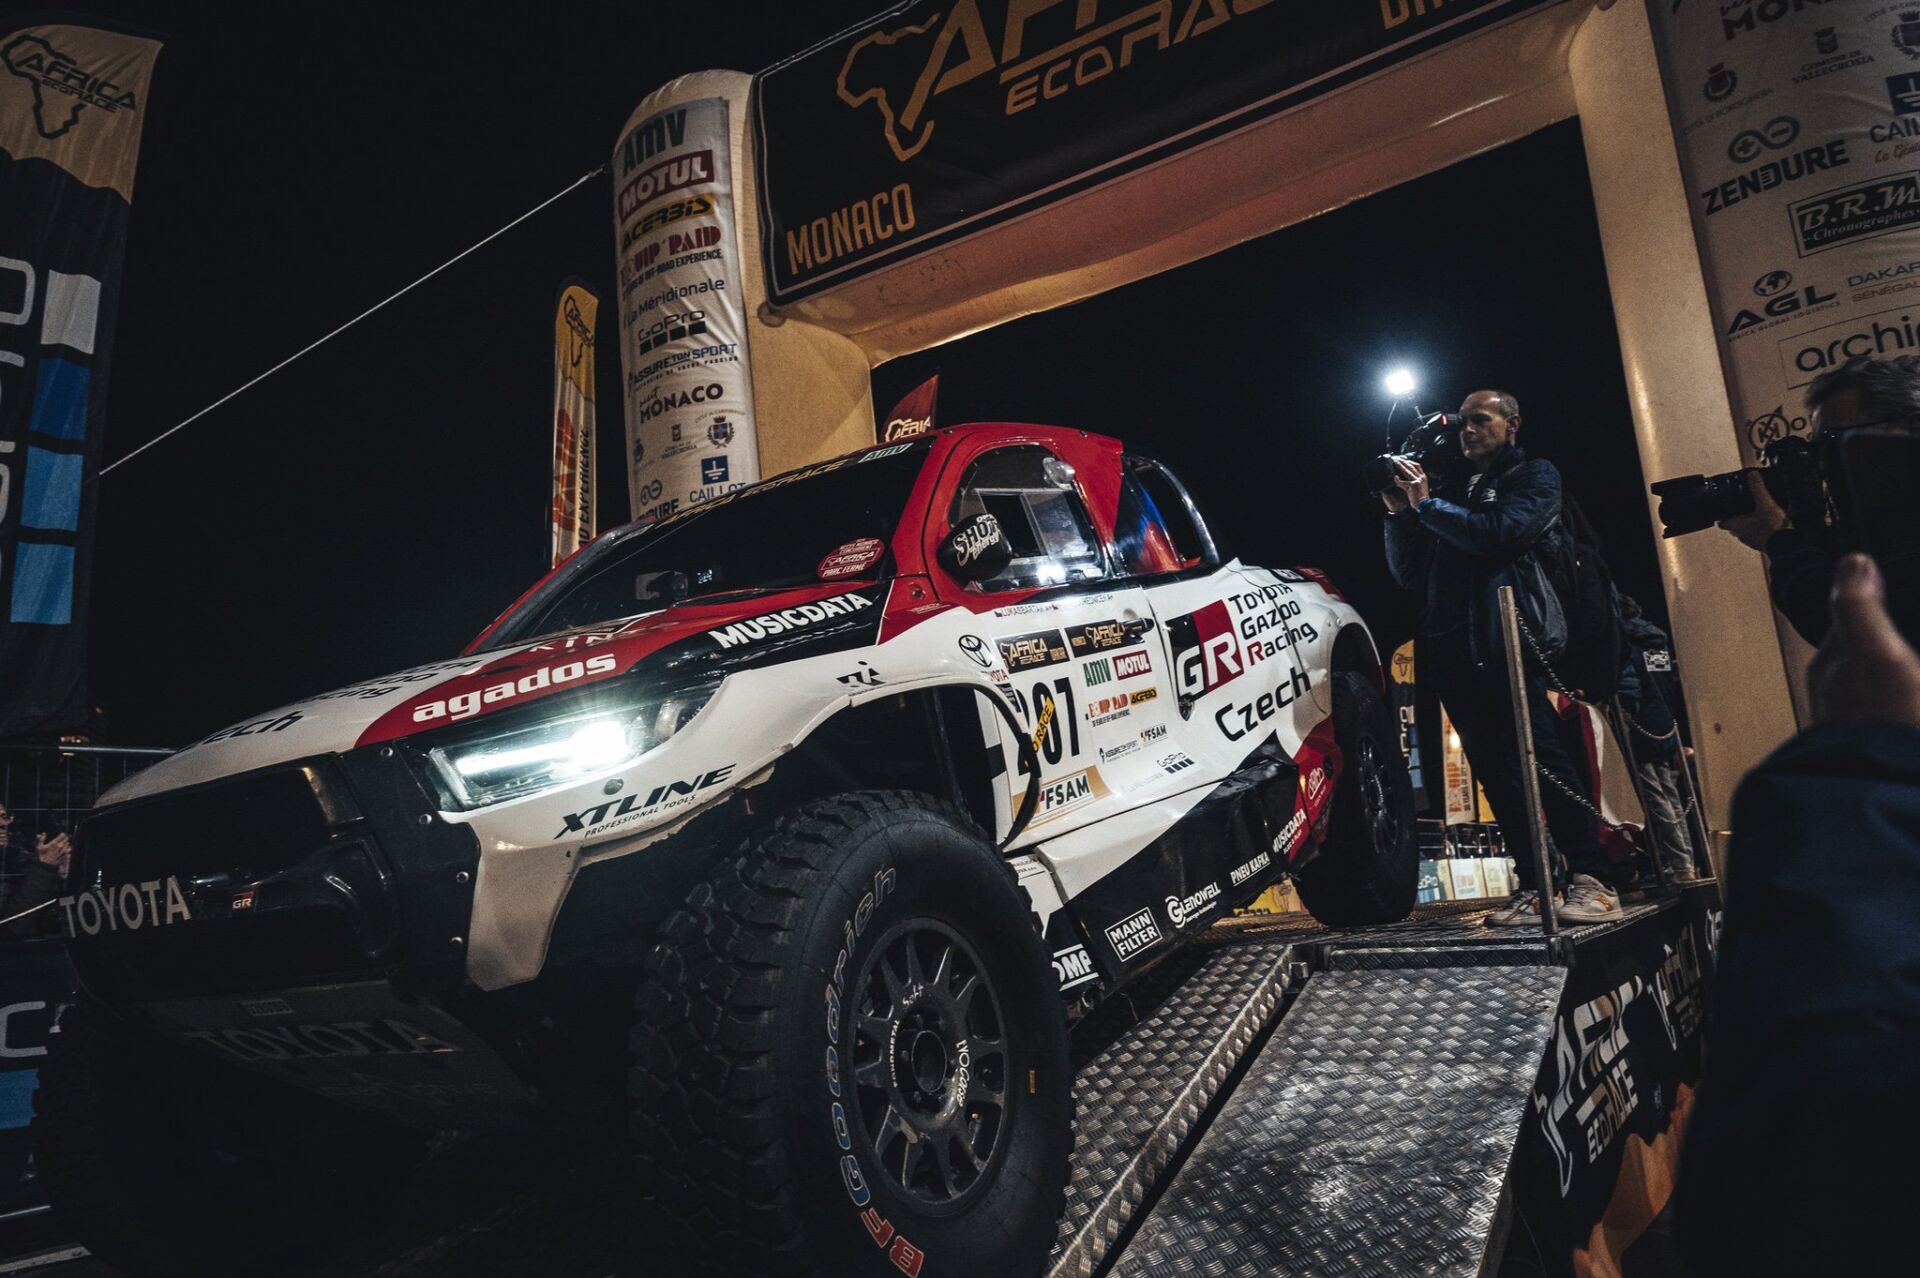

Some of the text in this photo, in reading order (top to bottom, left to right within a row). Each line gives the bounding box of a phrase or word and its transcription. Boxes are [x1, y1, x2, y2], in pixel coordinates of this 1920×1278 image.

[14, 53, 137, 111] AFRICA
[623, 108, 687, 179] AMV
[1869, 116, 1920, 143] CAIL
[620, 155, 708, 219] MOTUL
[1701, 138, 1850, 216] ZENDURE
[622, 196, 713, 252] ACERBIS
[787, 182, 917, 276] MONACO
[1812, 207, 1914, 243] Chronographes
[675, 249, 722, 268] EXPERIENCE
[638, 278, 726, 316] Méridionale
[1727, 285, 1838, 336] AGL
[638, 309, 706, 342] GoPro
[640, 383, 724, 425] MONACO
[577, 426, 590, 523] EXPERIENCE
[708, 593, 873, 649] MUSICDATA
[1229, 583, 1294, 615] TOYOTA
[1241, 600, 1302, 640] GAZOO
[1010, 638, 1048, 663] AFRICA
[1176, 631, 1242, 697] GR
[1246, 622, 1319, 666] Racing
[413, 652, 617, 723] agados
[1082, 653, 1150, 688] AMV MOTUL
[1036, 704, 1053, 740] RACE
[1215, 667, 1312, 742] Czech
[1147, 724, 1168, 741] FSAM
[1156, 751, 1187, 768] GoPro
[553, 763, 737, 841] XTLINE
[1045, 775, 1090, 810] FSAM
[584, 794, 697, 839] PROFESSIONAL TOOLS
[1272, 808, 1308, 854] MUSICDATA
[1230, 851, 1271, 884] PNEU KAFKA
[59, 874, 192, 939] TOYOTA
[231, 897, 254, 910] GR
[1109, 910, 1152, 943] MANN
[1115, 926, 1158, 957] FILTER
[825, 866, 925, 1278] BFGoodrich
[1587, 1057, 1639, 1165] ECORACE
